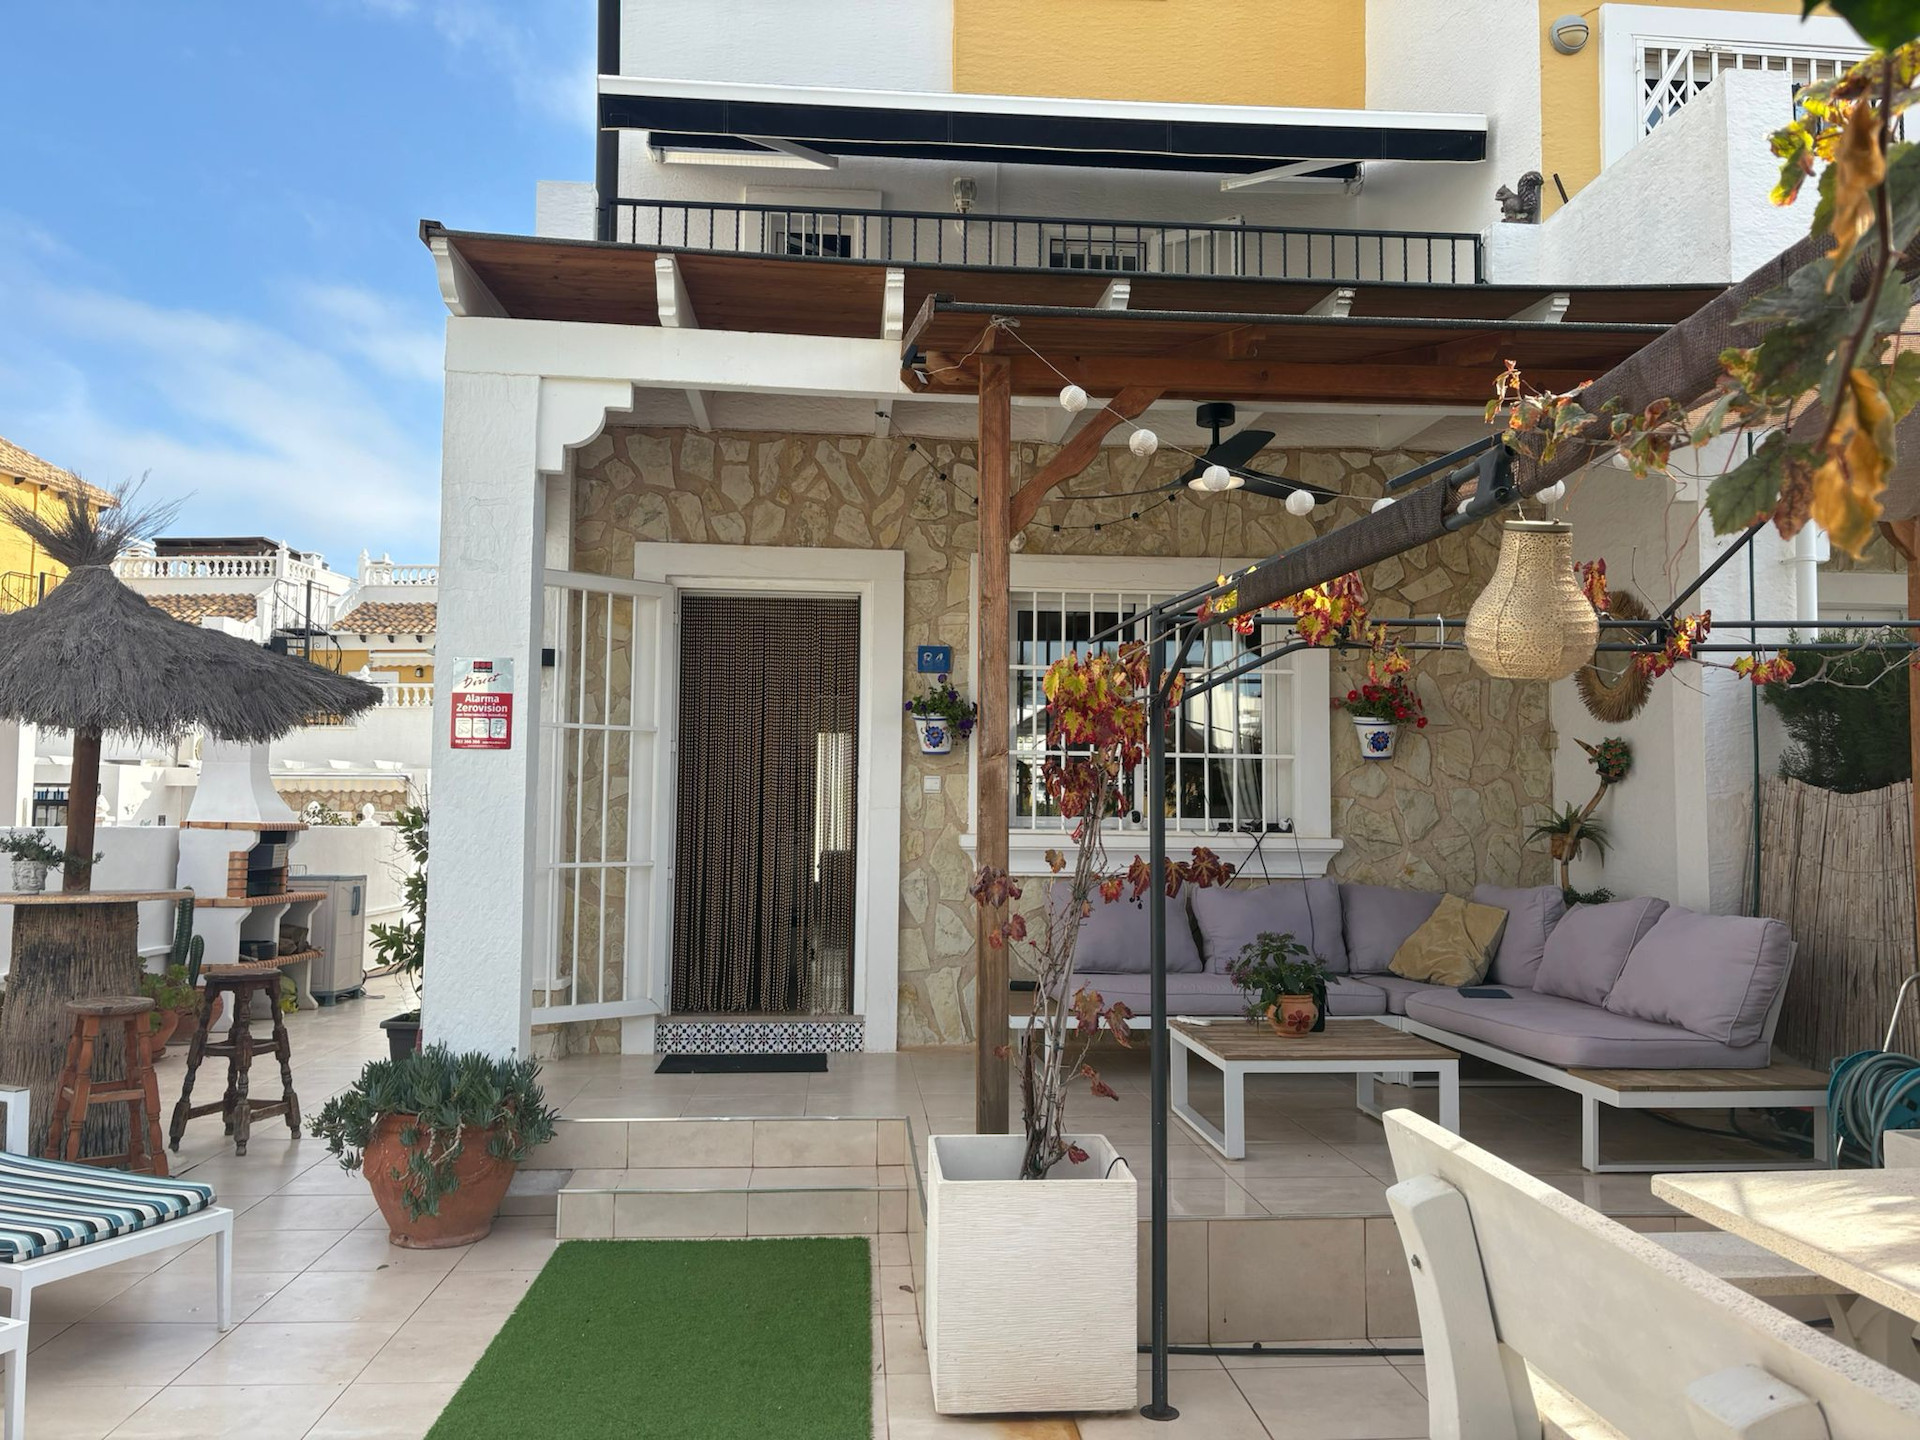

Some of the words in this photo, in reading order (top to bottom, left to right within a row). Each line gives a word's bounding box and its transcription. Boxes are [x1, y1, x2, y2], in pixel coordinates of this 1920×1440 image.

[461, 672, 503, 689] Direct
[465, 694, 499, 703] Alarma
[456, 703, 508, 713] Zerovision
